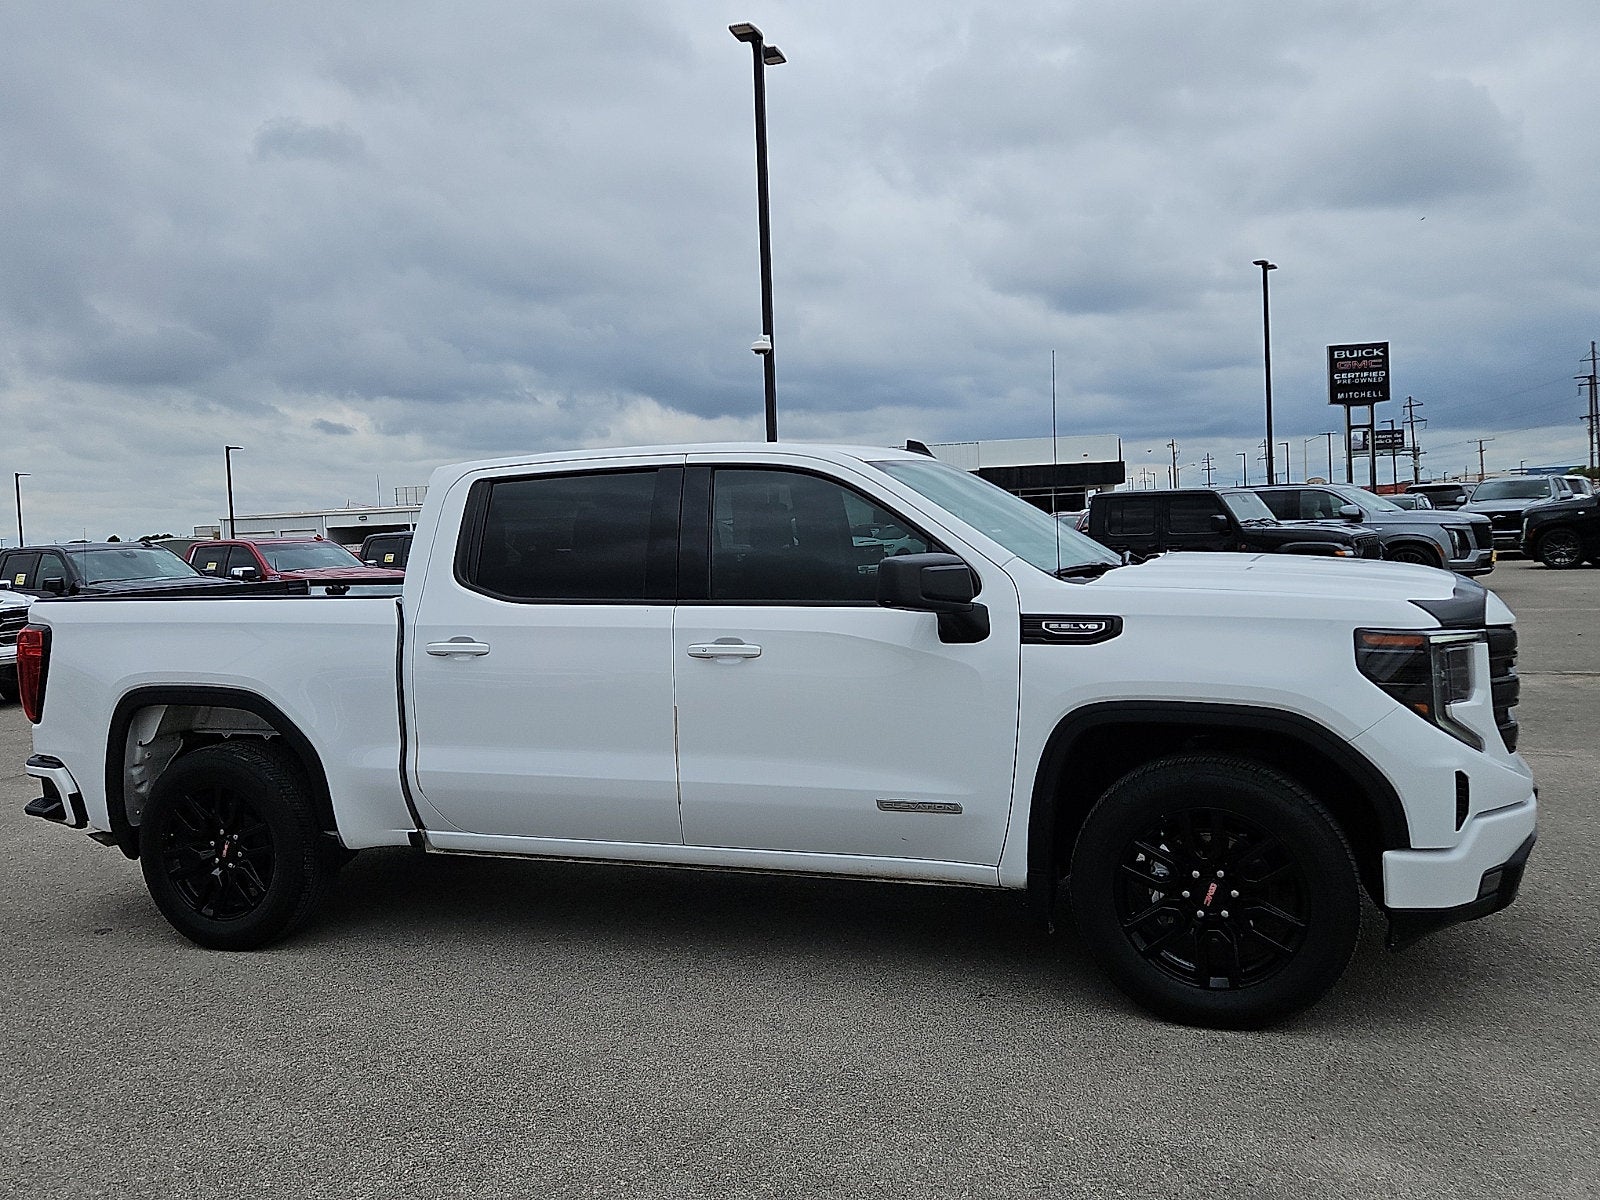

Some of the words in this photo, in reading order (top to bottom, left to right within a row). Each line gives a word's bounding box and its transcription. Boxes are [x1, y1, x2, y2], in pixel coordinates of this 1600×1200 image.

[1333, 348, 1385, 359] BUICK
[1336, 359, 1383, 370] GMC
[1333, 371, 1386, 380] CERTIFIED
[1336, 377, 1384, 385] PRE-OWNED
[1337, 390, 1383, 399] MITCHELL
[882, 802, 956, 810] ELEVATION
